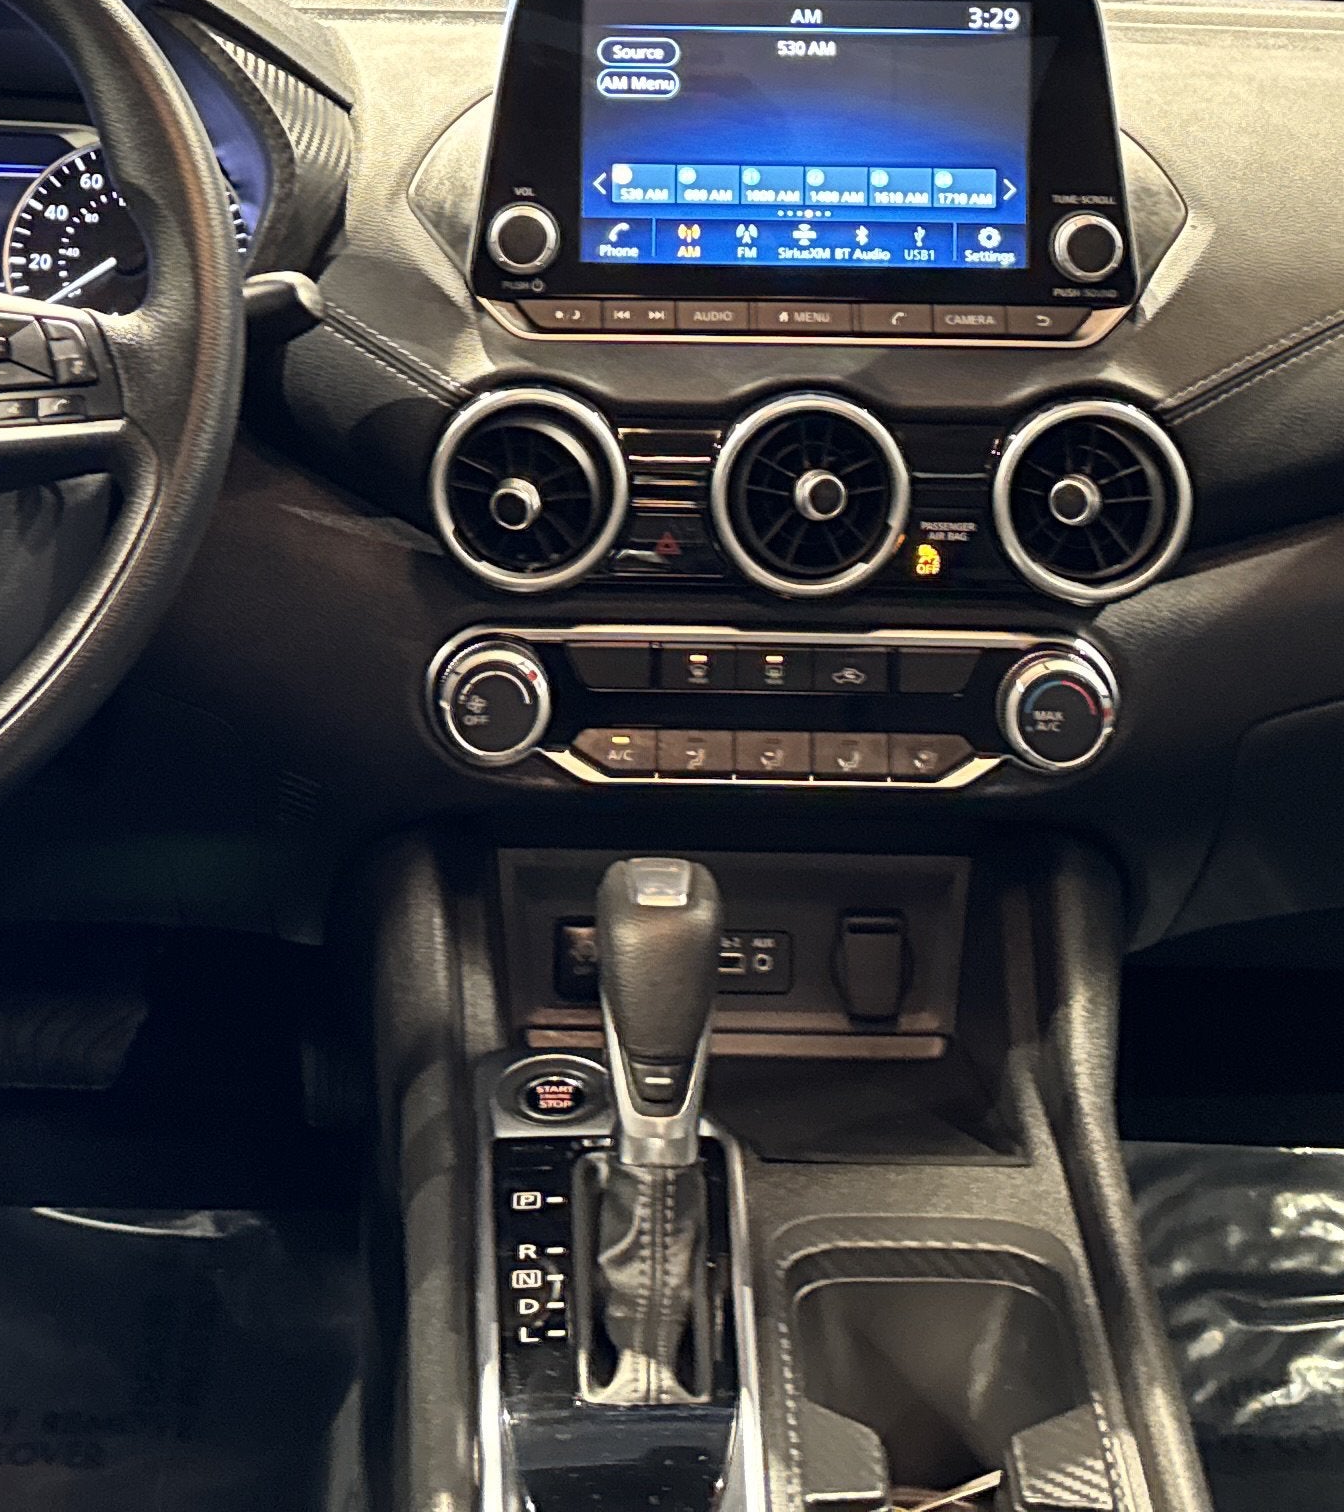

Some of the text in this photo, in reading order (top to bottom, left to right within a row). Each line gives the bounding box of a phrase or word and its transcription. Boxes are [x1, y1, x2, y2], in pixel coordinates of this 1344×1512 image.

[790, 8, 823, 25] AM
[968, 7, 1020, 30] 3:29
[613, 44, 665, 60] Source
[777, 41, 837, 56] 530 AM
[601, 74, 676, 92] AM Menu
[79, 172, 105, 191] 60
[514, 186, 536, 197] VOL
[645, 188, 670, 201] AM
[709, 189, 734, 202] AM
[777, 190, 801, 203] AM
[841, 191, 866, 204] AM
[905, 192, 930, 205] AM
[969, 193, 994, 205] AM
[43, 204, 70, 222] 40
[599, 244, 640, 258] Phone
[677, 246, 702, 258] AM
[737, 247, 758, 259] FM
[778, 247, 832, 260] SiriusXM
[835, 248, 892, 261] BT Audio
[904, 249, 935, 262] USB1
[28, 253, 54, 272] 20
[964, 249, 1016, 267] Settings
[692, 309, 734, 323] AUDIO
[794, 310, 832, 324] MENU
[944, 312, 995, 327] CAMERA
[919, 521, 978, 532] PASSENGER
[916, 563, 941, 575] OFF
[462, 714, 490, 727] OFF
[1031, 710, 1066, 722] MAX
[607, 749, 634, 763] A/C
[536, 1085, 575, 1094] START
[538, 1099, 574, 1109] STOP
[518, 1243, 538, 1260] R
[519, 1298, 540, 1315] D
[519, 1326, 541, 1343] L
